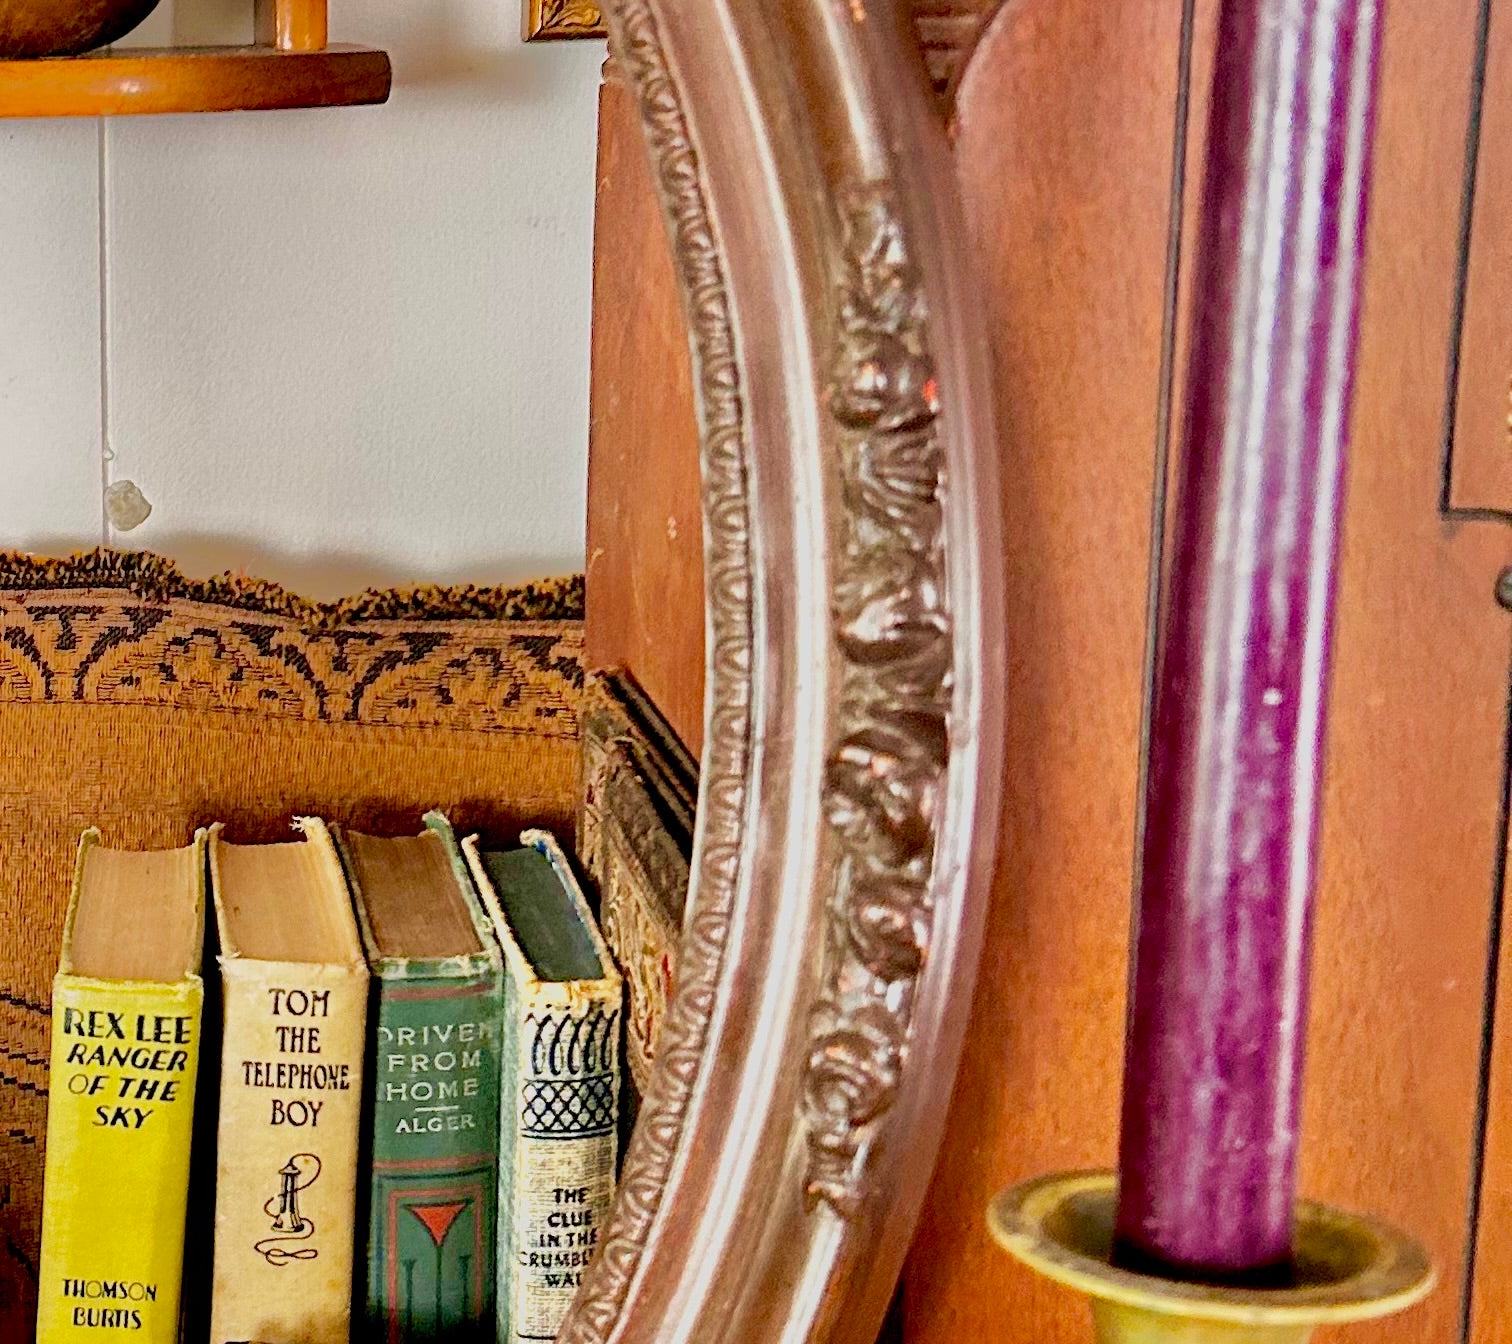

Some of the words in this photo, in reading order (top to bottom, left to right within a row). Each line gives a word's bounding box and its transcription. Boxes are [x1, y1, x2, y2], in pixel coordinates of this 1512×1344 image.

[268, 988, 331, 1017] TOM
[63, 1007, 125, 1039] REX
[136, 1014, 193, 1044] LEE
[275, 1026, 321, 1053] THE
[67, 1043, 188, 1072] RANGER
[387, 1049, 481, 1073] FROM
[68, 1073, 109, 1095] OF
[119, 1077, 180, 1101] THE
[242, 1061, 350, 1090] TELEPHONE
[386, 1078, 478, 1101] HOME
[92, 1105, 154, 1129] SKY
[270, 1099, 323, 1127] BOY
[395, 1114, 476, 1133] ALGER
[553, 1188, 589, 1203] THE
[547, 1210, 593, 1228] CLUE
[539, 1233, 560, 1248] IN
[568, 1228, 599, 1247] THE
[63, 1278, 157, 1302] THOMSON
[545, 1273, 582, 1288] WAL
[73, 1307, 142, 1329] BURTIS
